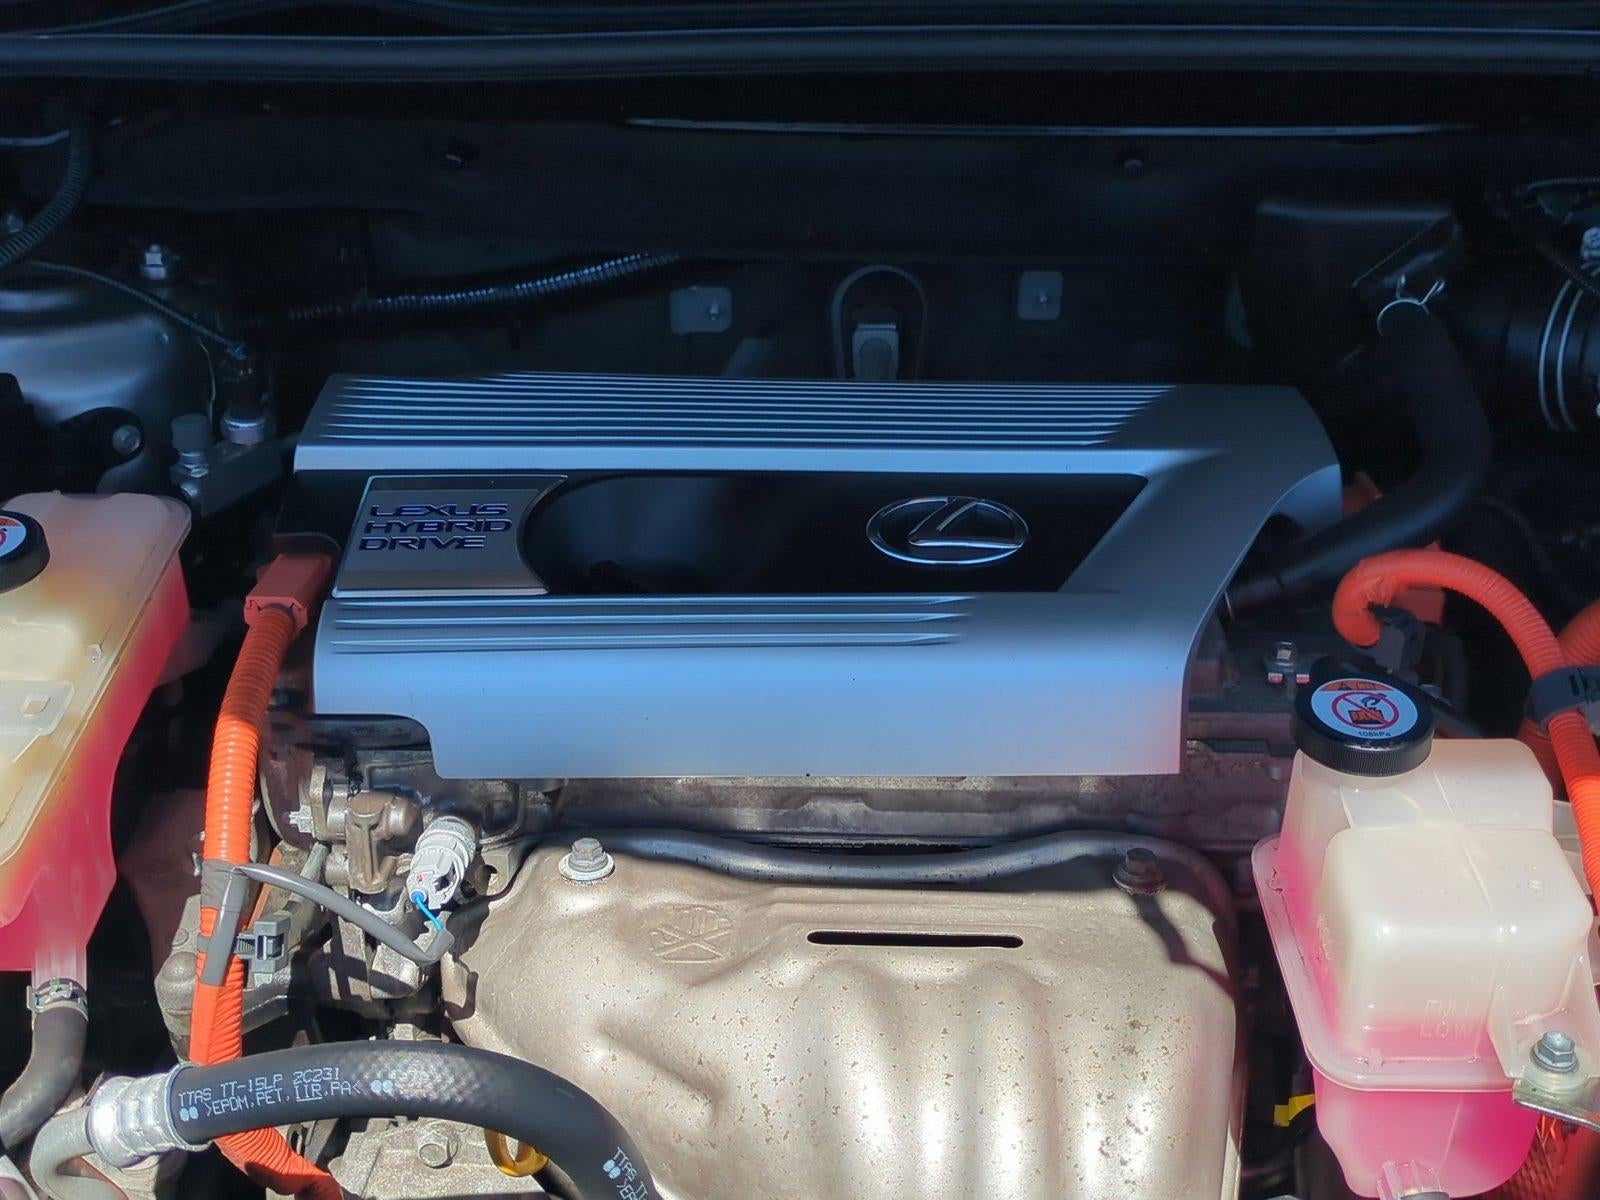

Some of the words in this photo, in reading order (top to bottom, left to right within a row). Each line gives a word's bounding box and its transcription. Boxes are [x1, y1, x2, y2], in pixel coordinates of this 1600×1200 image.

[369, 503, 509, 517] LEXUS
[364, 518, 513, 533] HYBRID
[358, 535, 487, 550] DRIVE
[178, 1087, 212, 1107] TTAS
